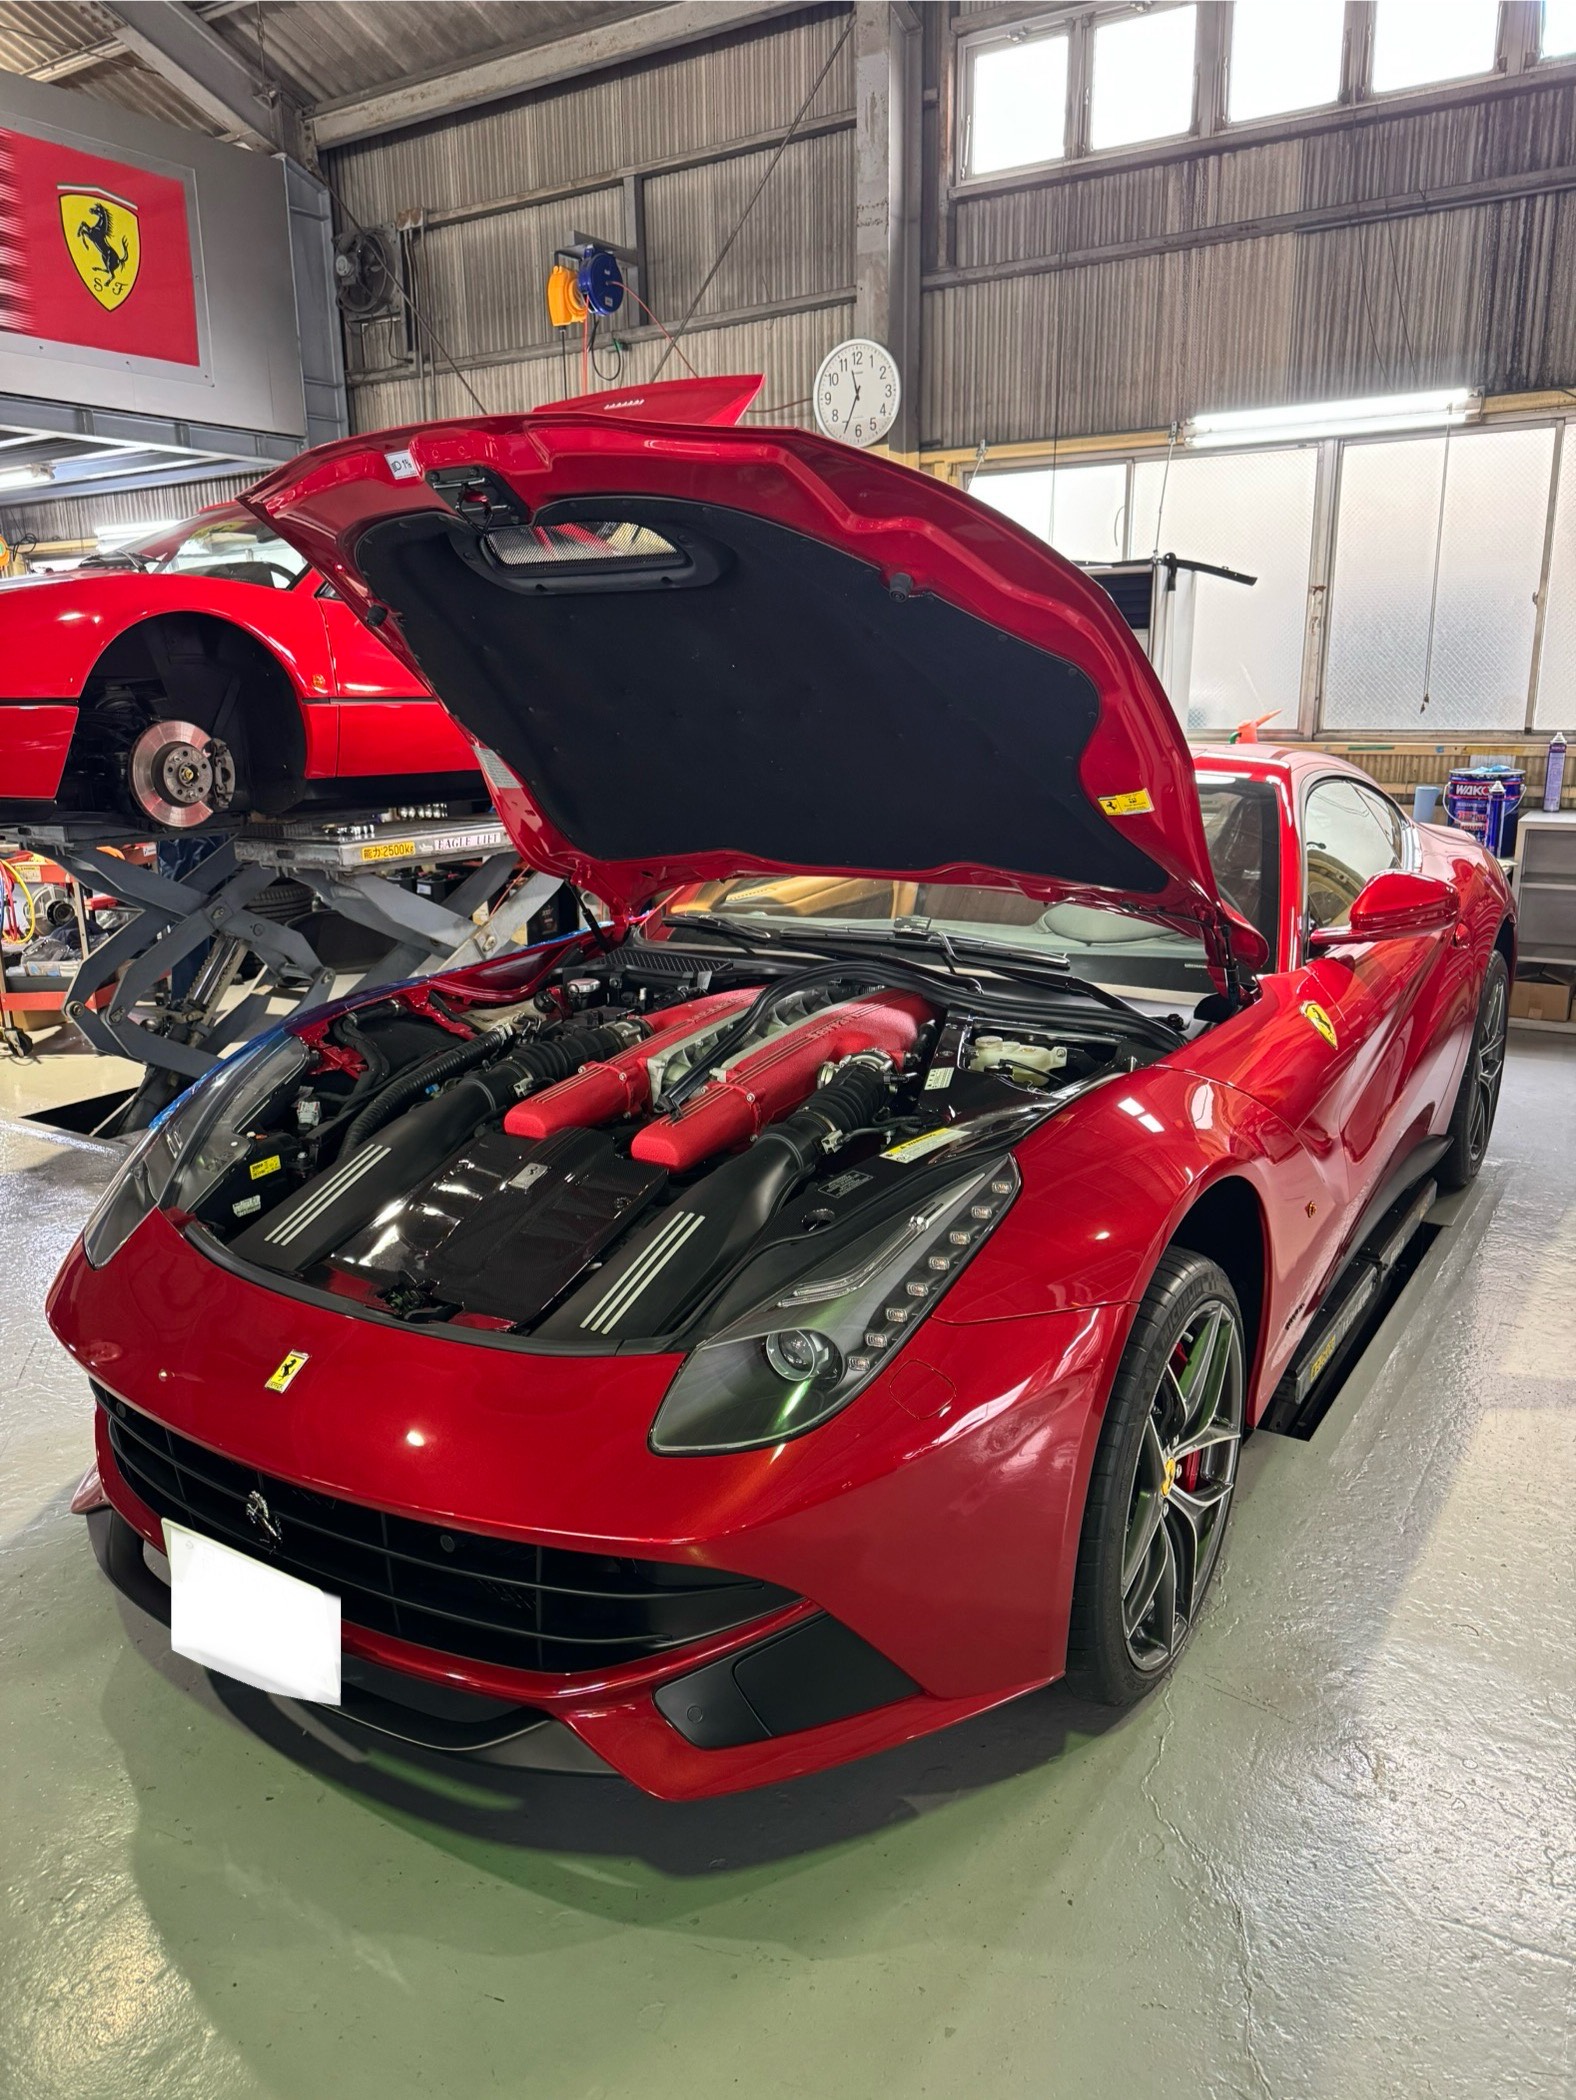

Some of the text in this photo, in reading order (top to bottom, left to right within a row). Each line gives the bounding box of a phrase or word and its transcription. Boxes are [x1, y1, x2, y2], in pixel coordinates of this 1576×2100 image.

[93, 277, 103, 292] S
[840, 358, 848, 372] 11
[852, 351, 863, 366] 12
[869, 354, 874, 369] 1
[828, 372, 839, 387] 10
[879, 365, 887, 380] 2
[885, 384, 893, 398] 3
[824, 392, 832, 406] 9
[831, 408, 839, 423] 8
[879, 403, 886, 417] 4
[855, 424, 863, 438] 6
[869, 417, 877, 431] 5
[438, 837, 471, 850] EAGLE
